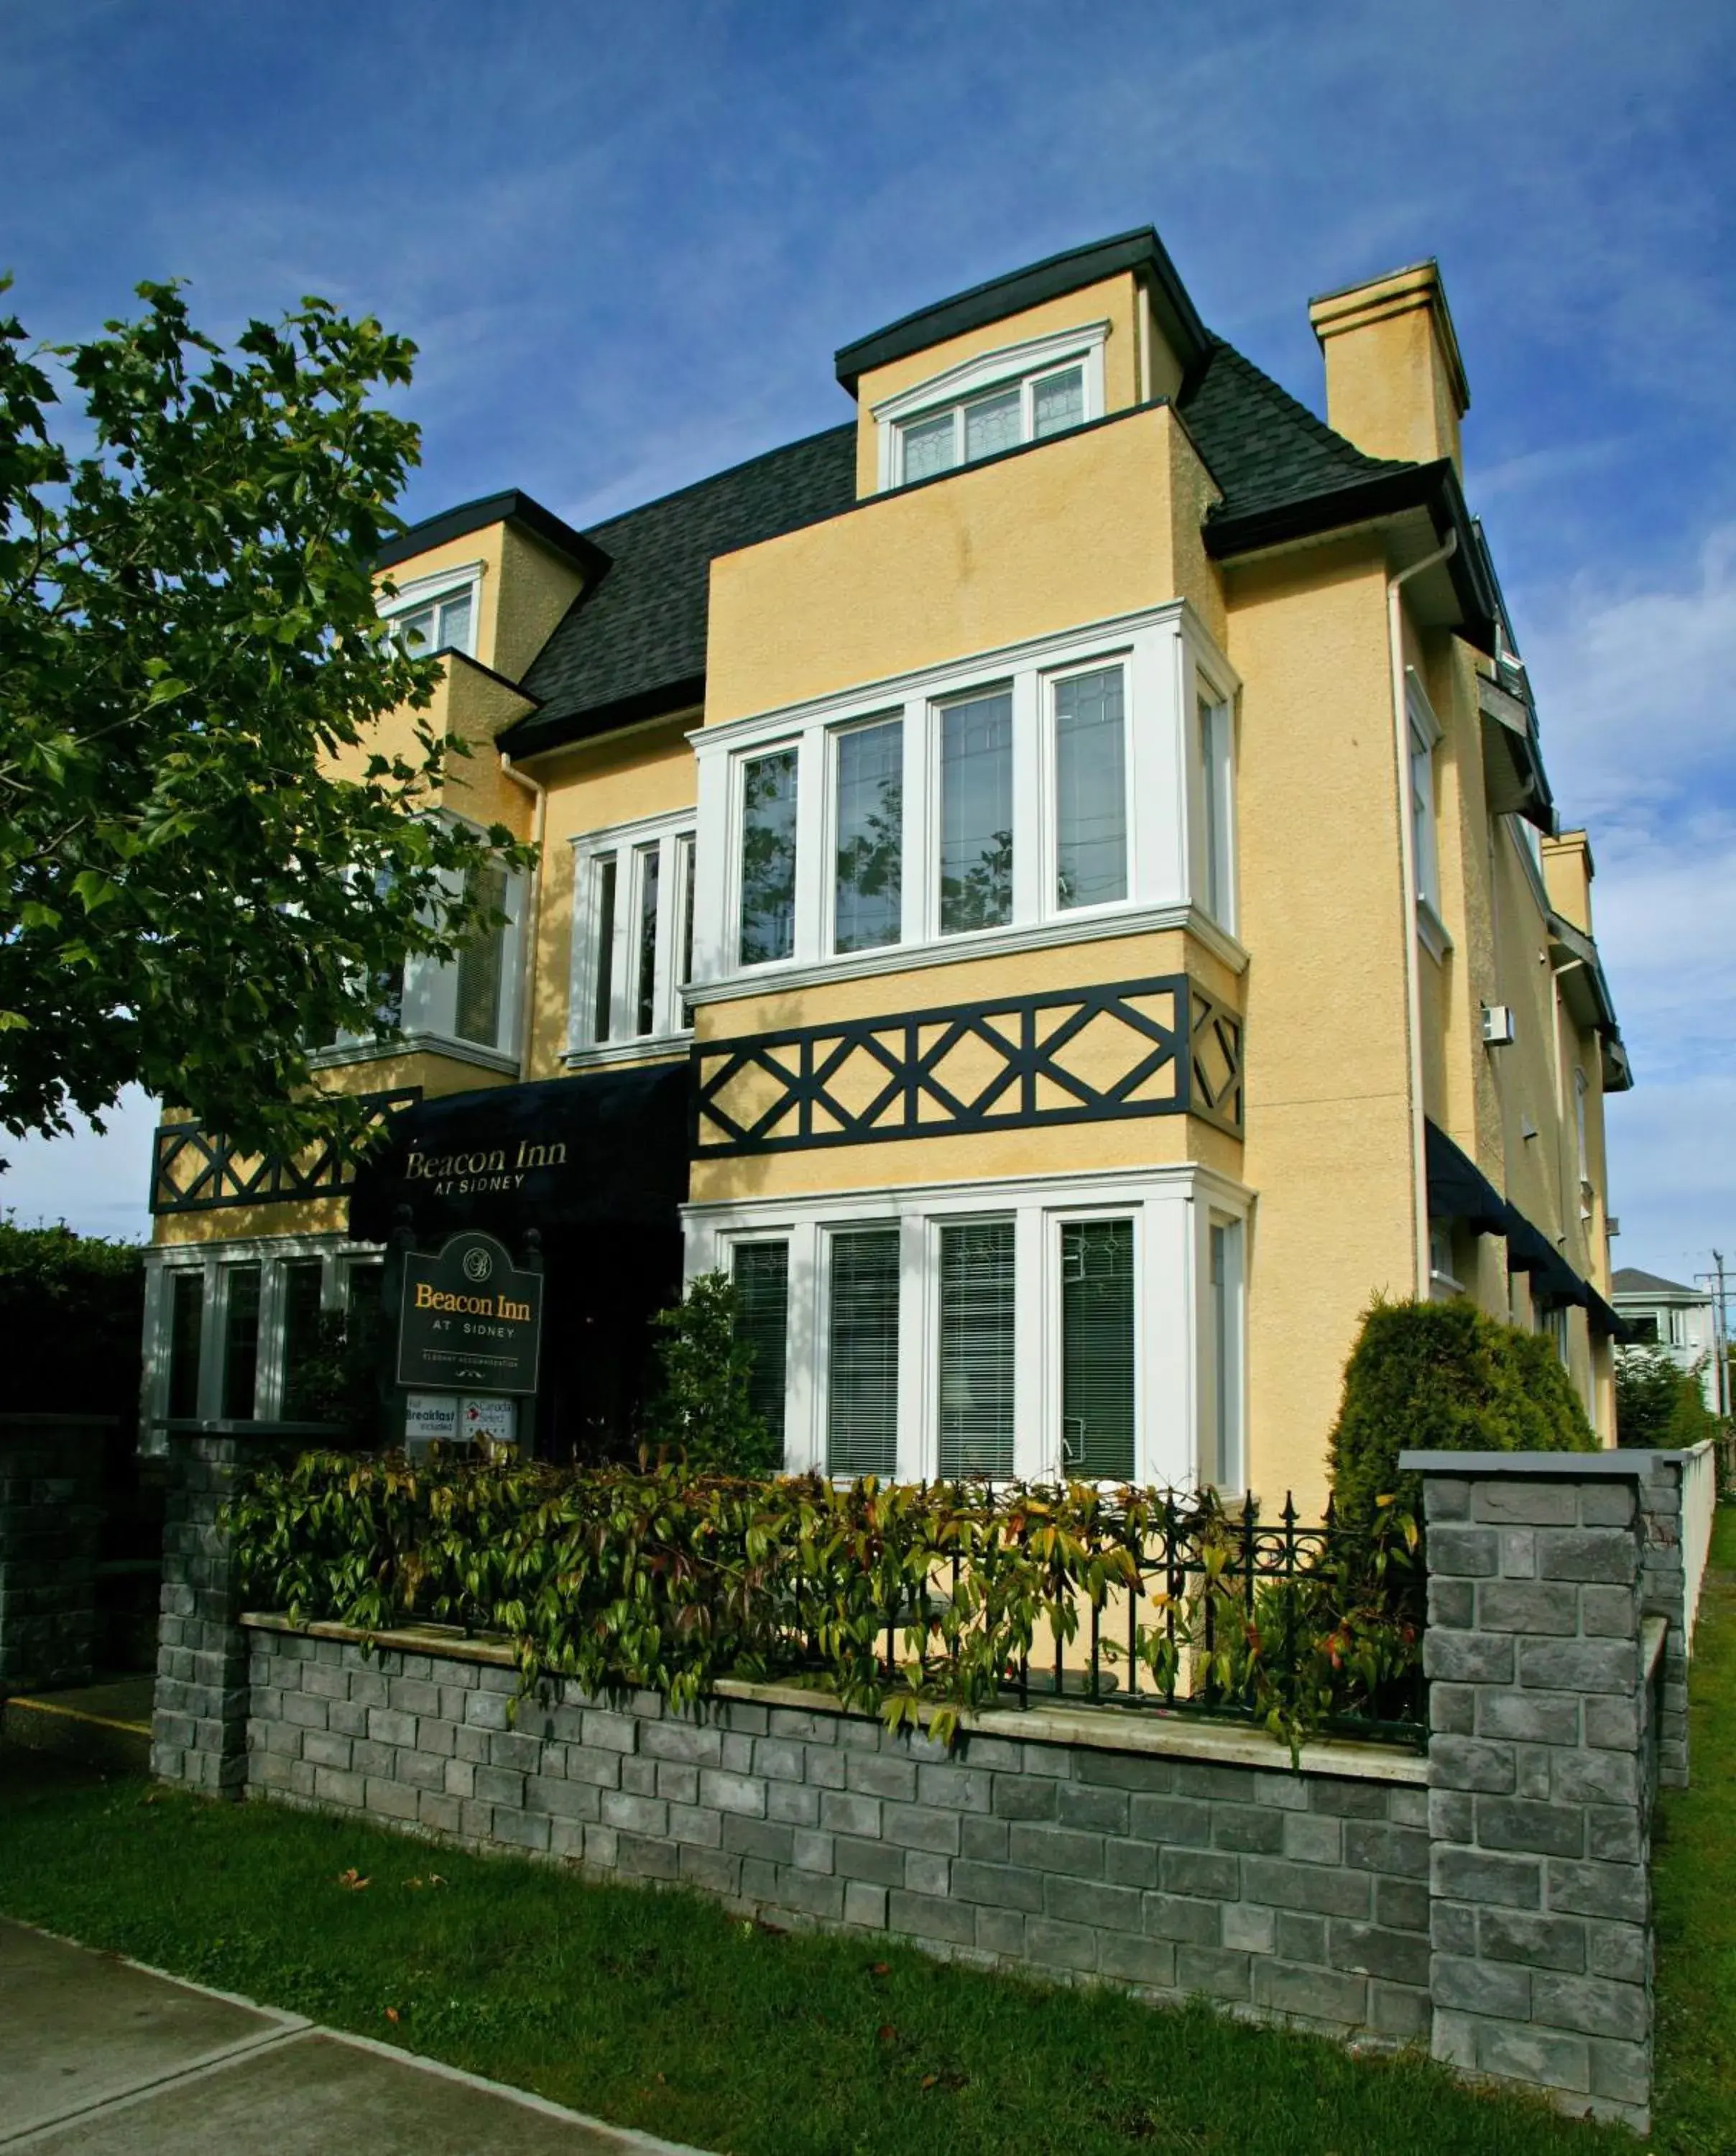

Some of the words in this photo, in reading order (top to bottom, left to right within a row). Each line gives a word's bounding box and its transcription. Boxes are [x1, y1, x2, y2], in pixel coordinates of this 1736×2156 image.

[404, 1148, 505, 1179] Beacon
[514, 1140, 568, 1169] Inn
[434, 1181, 453, 1195] AT
[459, 1174, 525, 1194] SIDNEY
[415, 1283, 493, 1316] Beacon
[497, 1294, 531, 1322] Inn
[433, 1319, 452, 1331] AT
[463, 1323, 515, 1339] SIDNEY
